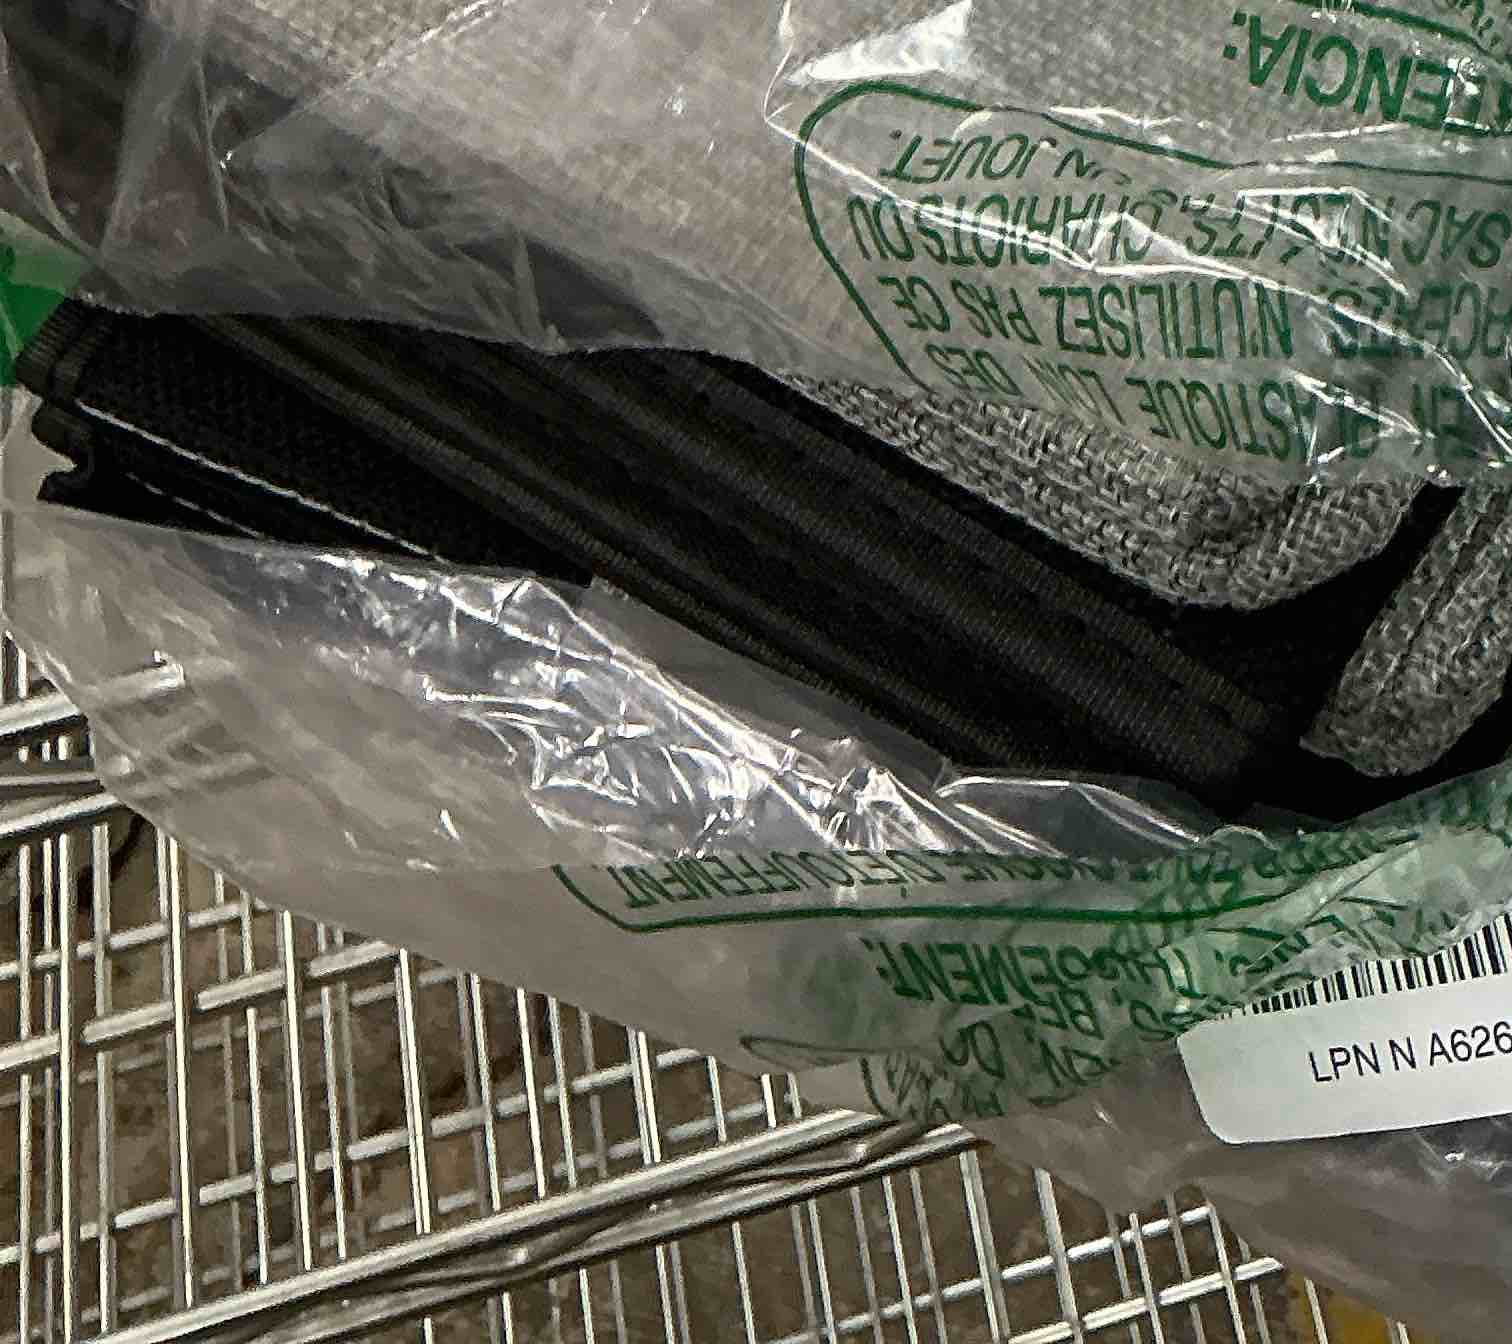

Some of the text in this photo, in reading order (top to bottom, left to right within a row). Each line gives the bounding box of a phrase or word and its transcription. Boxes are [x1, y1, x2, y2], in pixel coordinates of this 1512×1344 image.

[844, 198, 912, 260] OU
[1399, 198, 1512, 268] SAC
[873, 275, 1291, 359] N'UTILISEZ PAS CE
[924, 344, 1019, 398] DES
[1307, 1042, 1381, 1084] LPN
[1388, 1036, 1417, 1068] N
